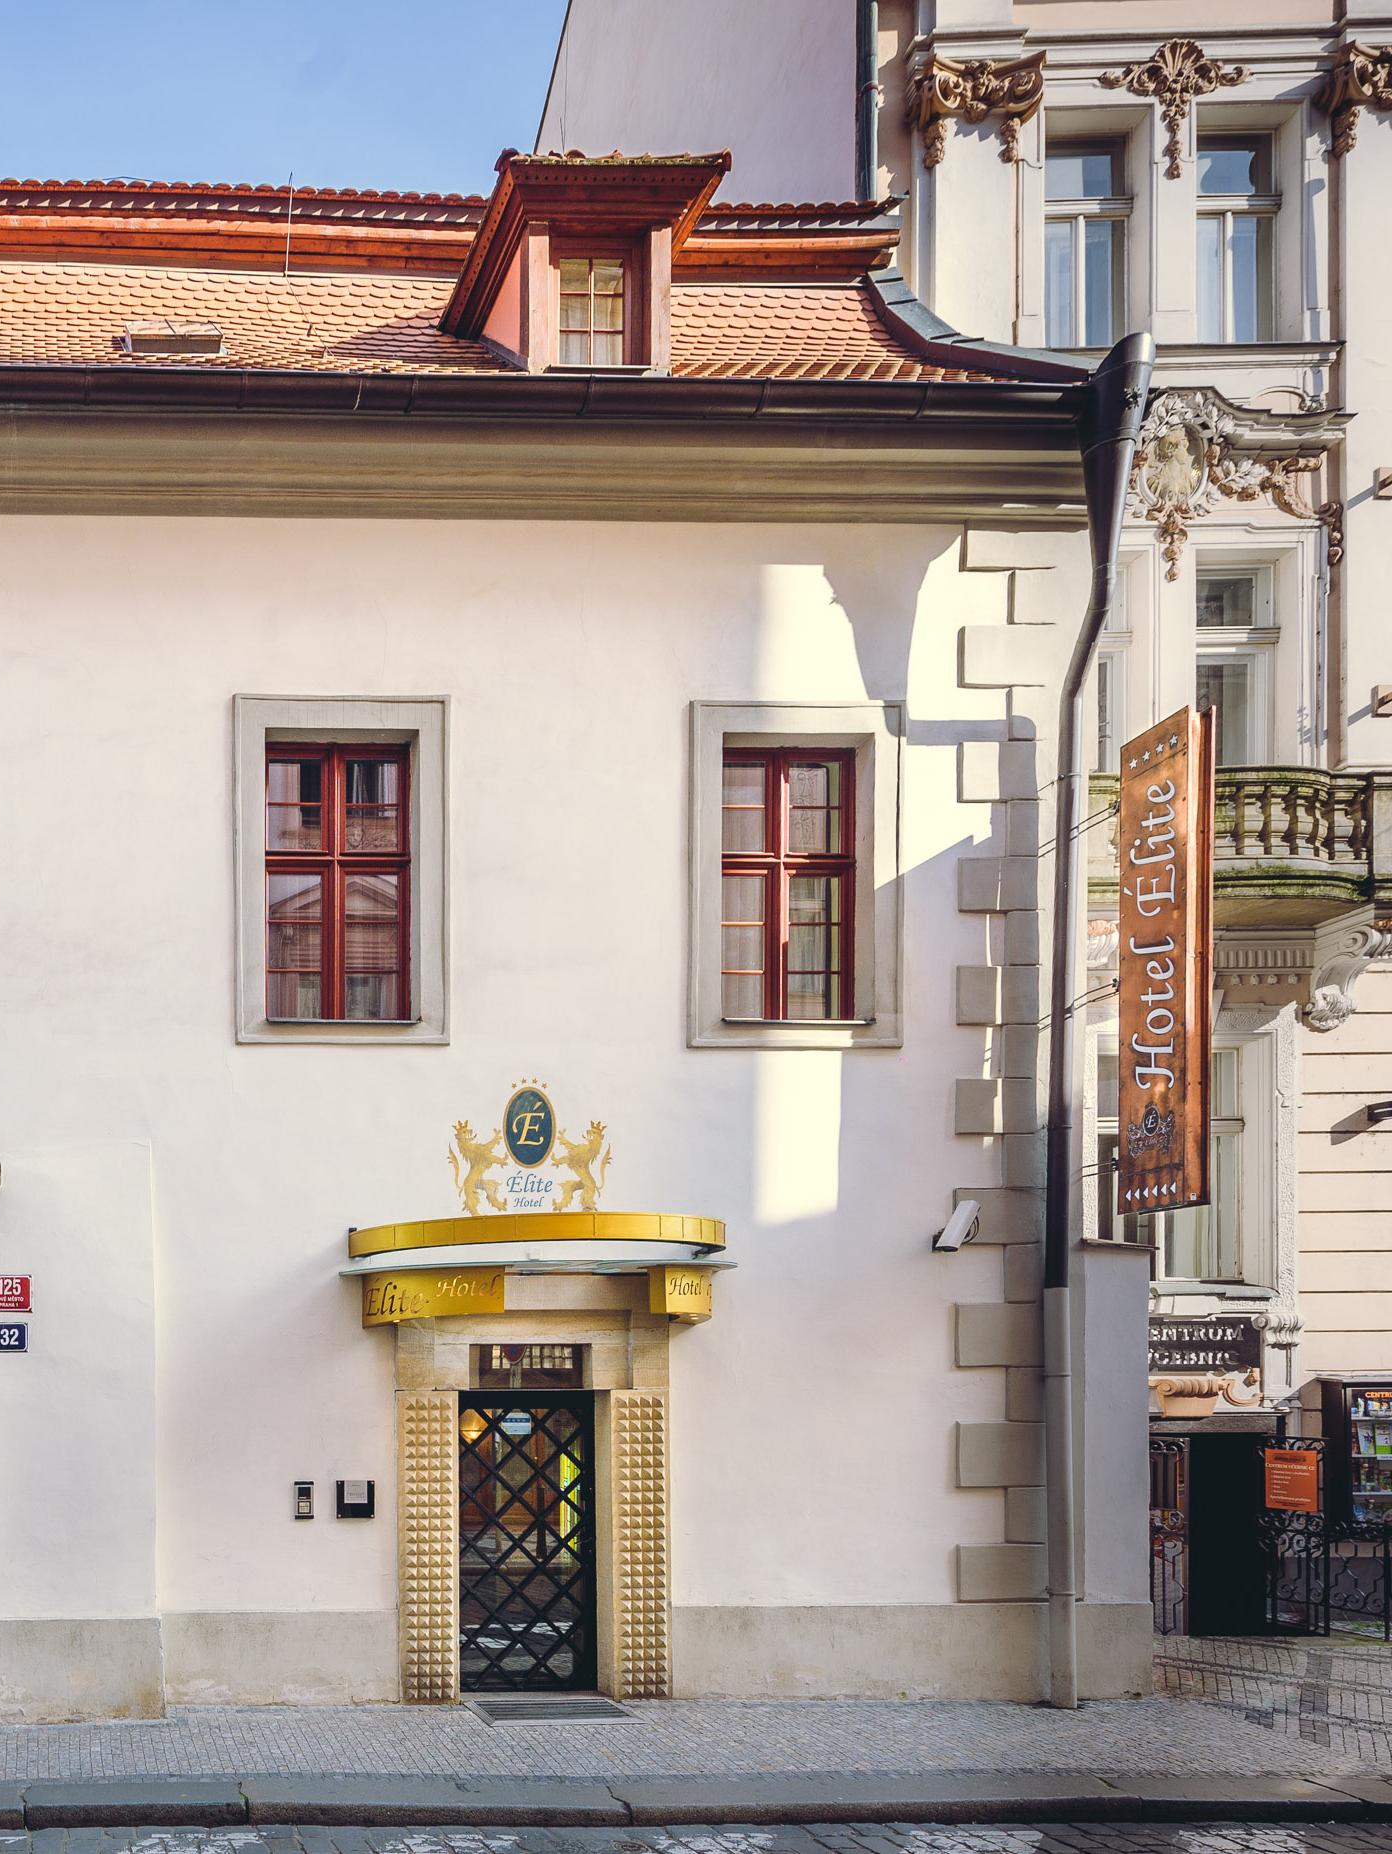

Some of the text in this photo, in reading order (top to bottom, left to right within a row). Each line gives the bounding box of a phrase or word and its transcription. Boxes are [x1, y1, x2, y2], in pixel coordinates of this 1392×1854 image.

[1123, 779, 1176, 917] Élite
[1129, 935, 1176, 1090] Hotel
[512, 1101, 545, 1146] É
[506, 1170, 553, 1193] Élite
[513, 1196, 545, 1208] Hotel
[365, 1274, 502, 1316] Élite Hotel
[668, 1273, 704, 1296] Hotel
[0, 1328, 19, 1345] 32
[1148, 1324, 1245, 1341] ENTRUM
